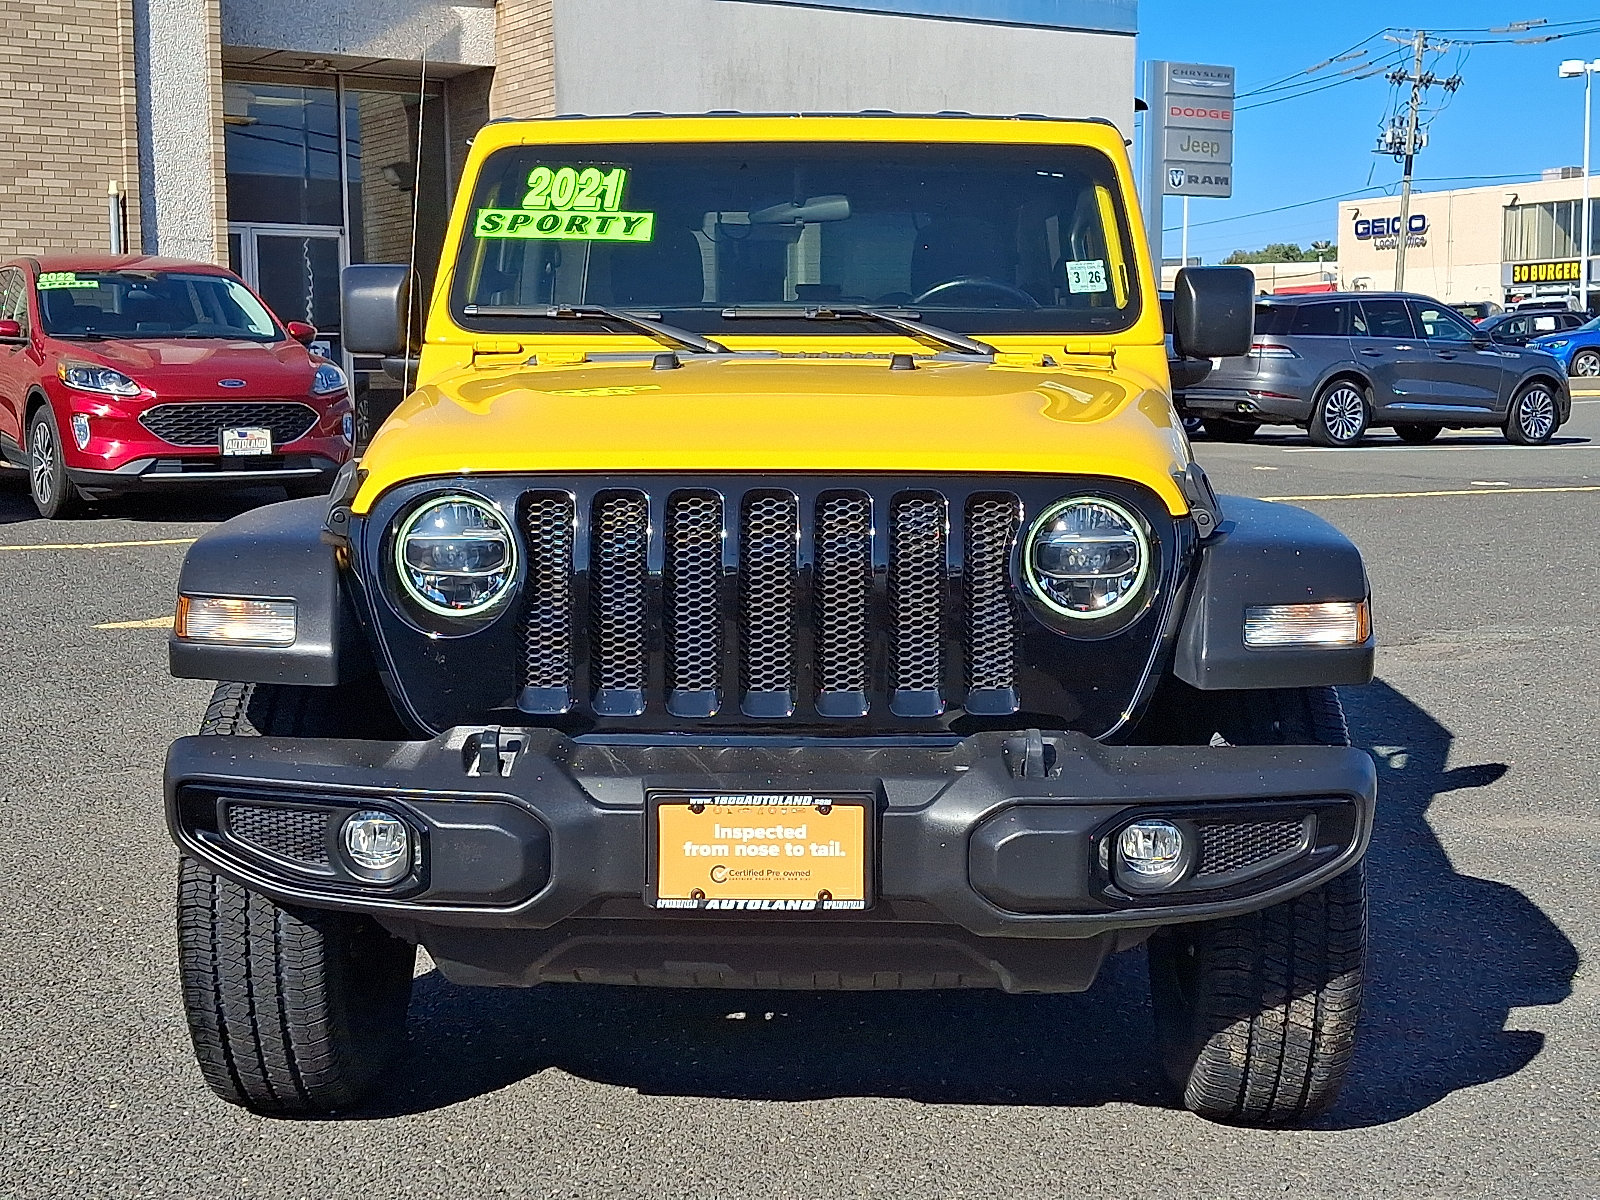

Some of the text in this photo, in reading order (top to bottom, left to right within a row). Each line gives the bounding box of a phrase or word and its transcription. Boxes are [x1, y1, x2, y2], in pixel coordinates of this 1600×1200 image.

[1172, 69, 1231, 79] CHRYSLER
[1170, 106, 1231, 120] DODGE
[1180, 135, 1220, 157] Jeep
[1187, 174, 1229, 186] RAM
[522, 166, 627, 211] 2021
[480, 213, 647, 235] SPORTY
[1354, 214, 1426, 238] GEICO
[38, 272, 76, 282] 2022
[1073, 271, 1101, 283] 3 26
[1513, 262, 1581, 282] 30 BURGER
[226, 438, 267, 449] AUTOLAND
[714, 823, 807, 842] Inspected
[683, 841, 846, 857] from nose to tail.
[729, 869, 764, 877] Certified
[783, 869, 811, 877] owned
[705, 899, 818, 911] AUTOLAND
